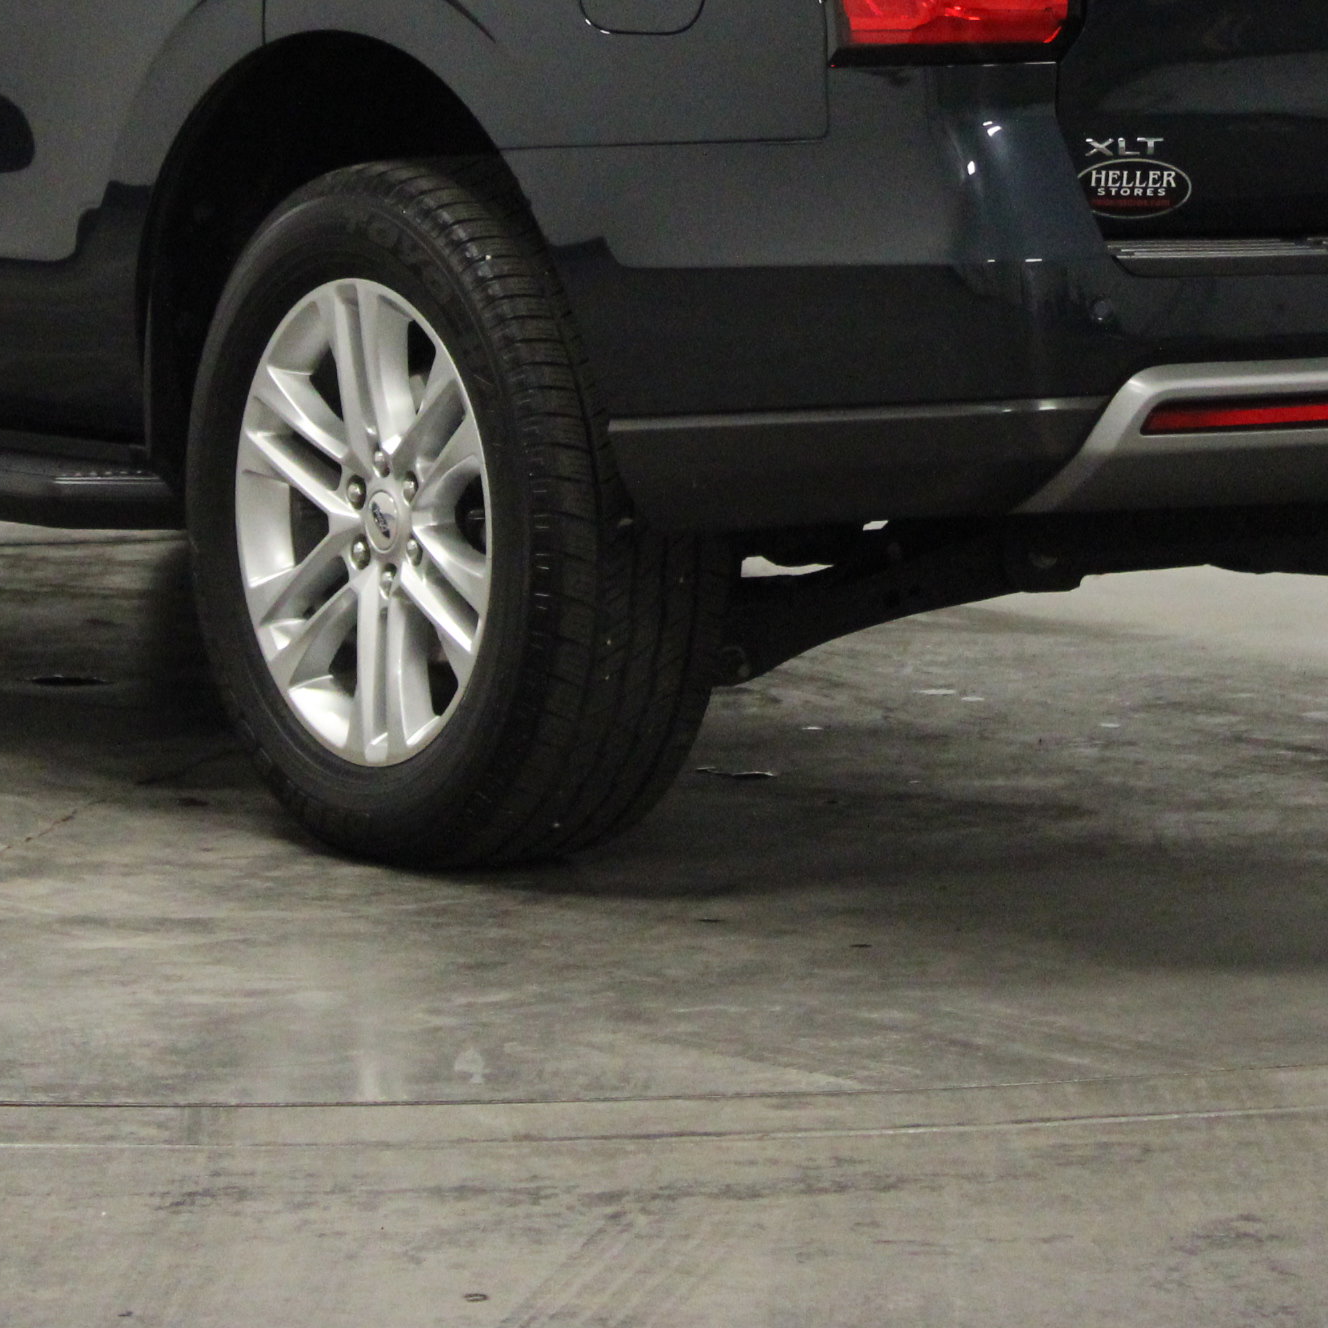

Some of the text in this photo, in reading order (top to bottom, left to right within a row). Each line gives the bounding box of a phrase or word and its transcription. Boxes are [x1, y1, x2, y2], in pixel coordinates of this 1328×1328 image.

[1085, 137, 1165, 157] XLT
[1091, 170, 1177, 188] HELLER
[1097, 188, 1167, 197] STORES
